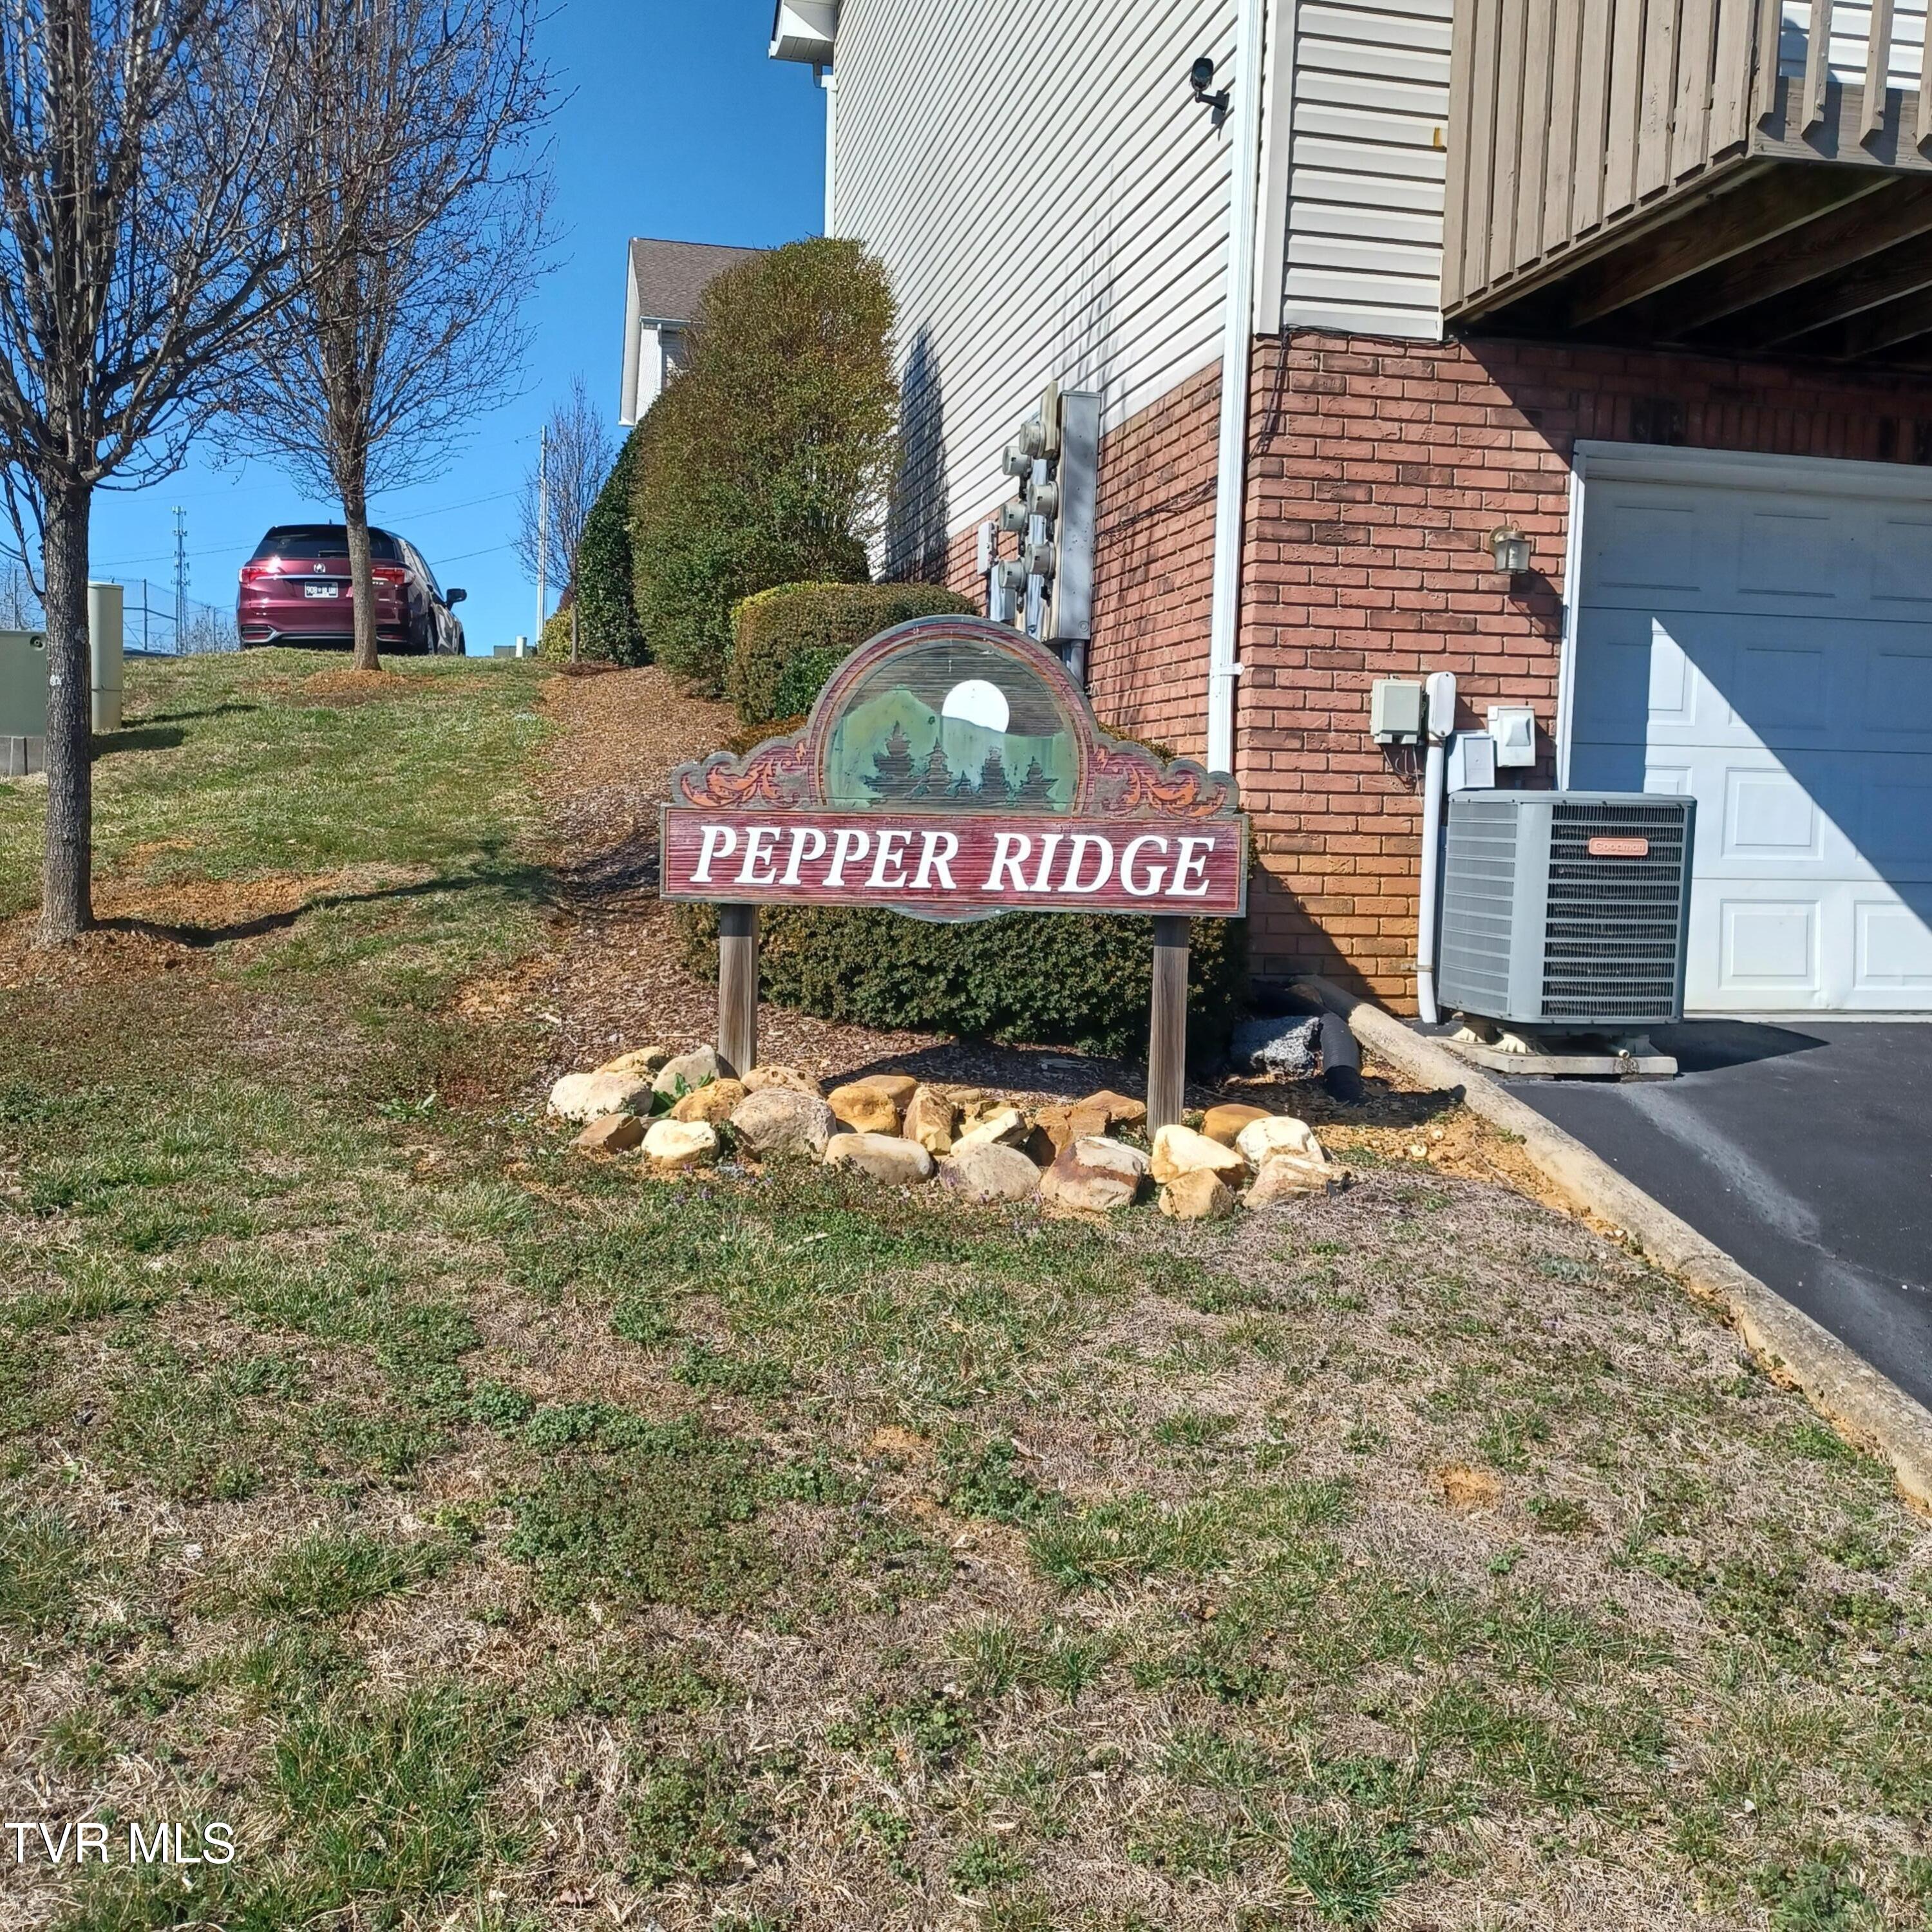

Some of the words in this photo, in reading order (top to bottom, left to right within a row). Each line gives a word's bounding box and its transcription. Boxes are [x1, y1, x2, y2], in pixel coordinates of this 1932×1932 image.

[690, 826, 958, 889] PEPPER
[982, 833, 1215, 895] RIDGE
[1595, 842, 1644, 852] Goodman
